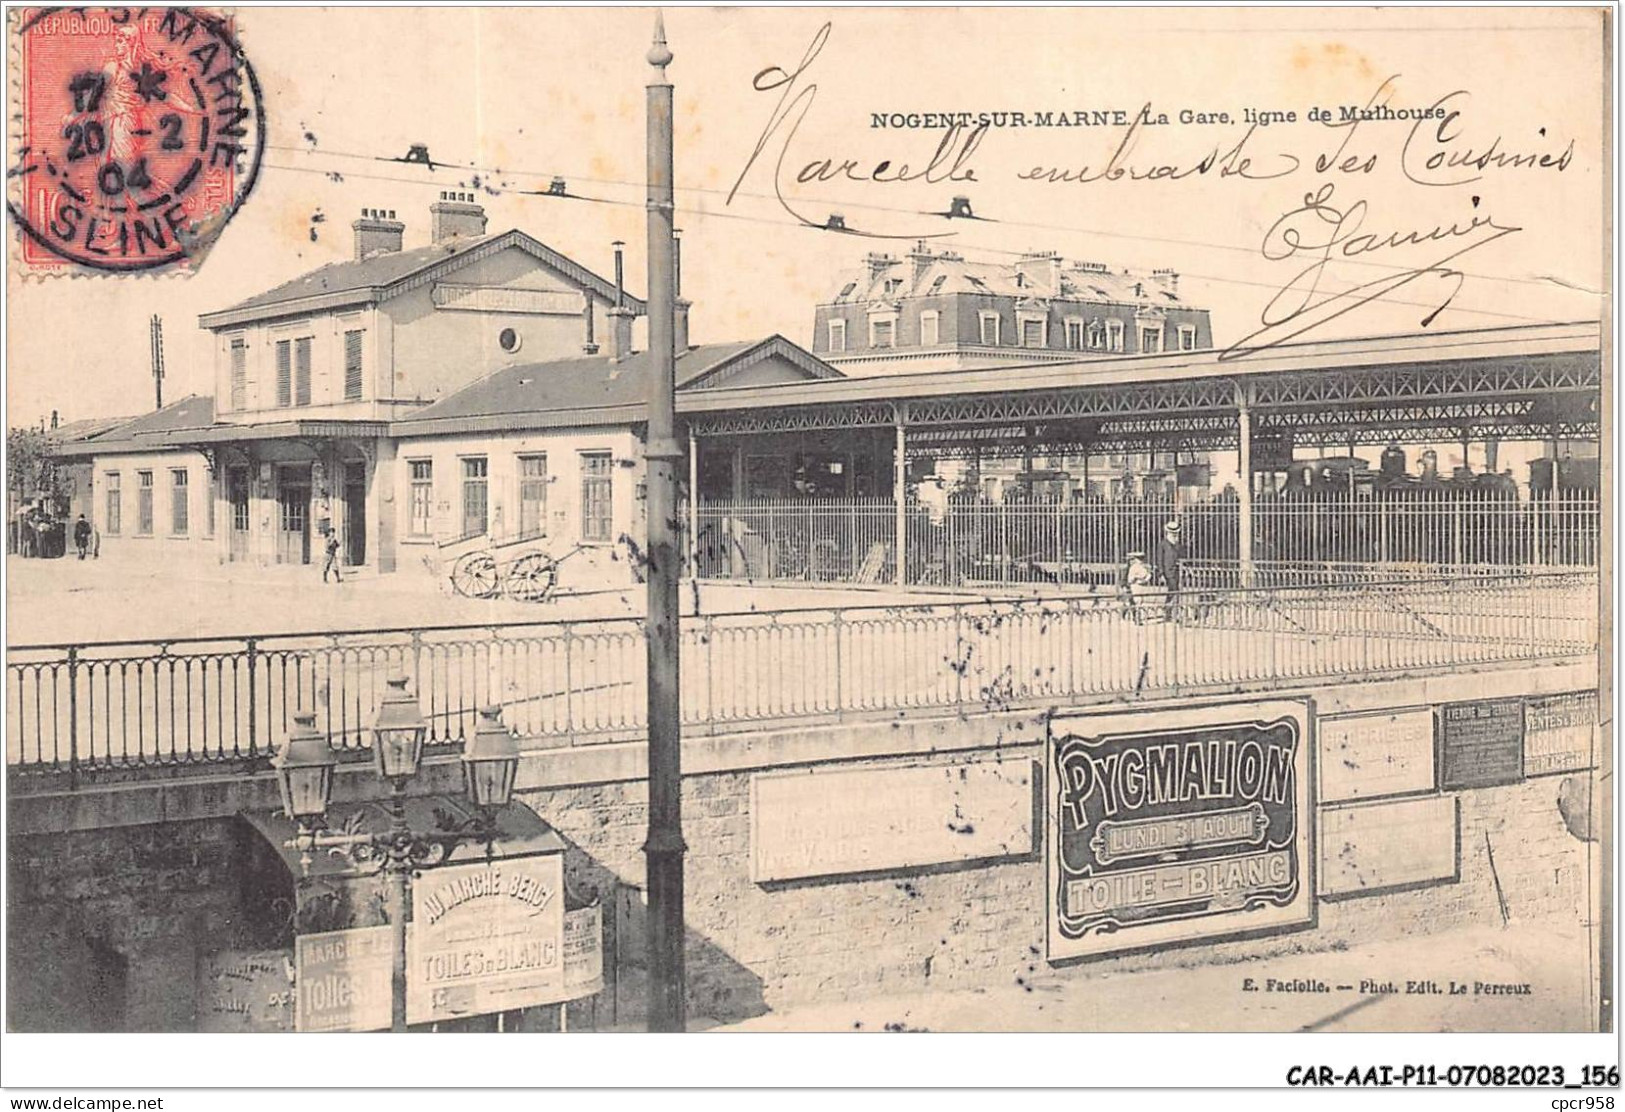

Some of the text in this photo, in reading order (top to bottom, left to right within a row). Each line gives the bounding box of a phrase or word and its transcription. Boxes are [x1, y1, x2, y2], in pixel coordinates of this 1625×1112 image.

[1142, 109, 1169, 126] La
[1179, 109, 1235, 125] Gare,
[1244, 107, 1297, 126] ligne
[1308, 107, 1332, 122] de
[1060, 741, 1292, 830] PYGMALION
[1111, 822, 1167, 854] LUNDI
[1176, 821, 1197, 843] 31
[1071, 871, 1157, 912] TOILE
[1189, 854, 1286, 896] BLANC
[1242, 979, 1259, 992] E.
[1359, 979, 1399, 994] Phot.
[1406, 980, 1443, 995] Edit.
[1450, 981, 1468, 995] Le
[1474, 981, 1532, 996] Perreux
